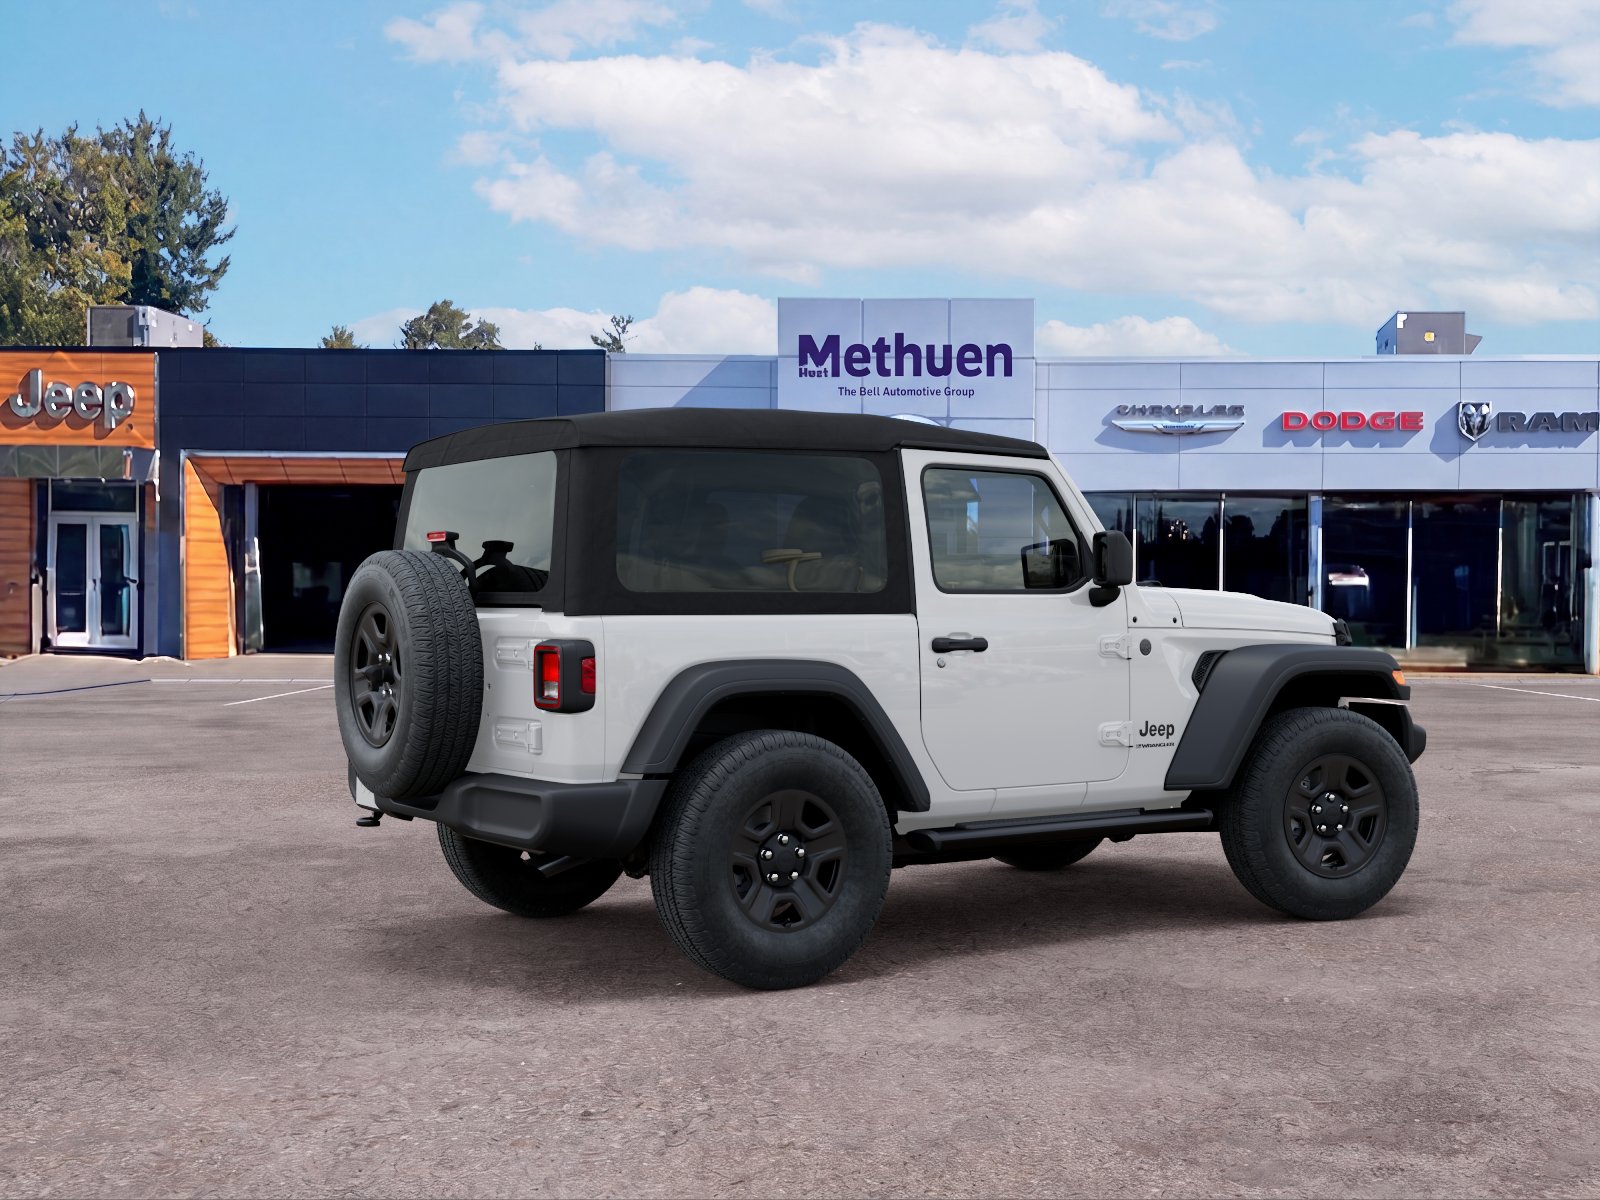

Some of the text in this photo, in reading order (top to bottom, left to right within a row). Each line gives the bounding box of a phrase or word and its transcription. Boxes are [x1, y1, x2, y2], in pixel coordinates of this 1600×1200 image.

[798, 333, 1013, 378] Methuen
[9, 368, 135, 429] Jeep
[838, 386, 975, 399] The Bell Automotive Group
[1282, 411, 1424, 431] DODGE
[1498, 411, 1600, 432] RAM
[1139, 720, 1175, 740] Jeep
